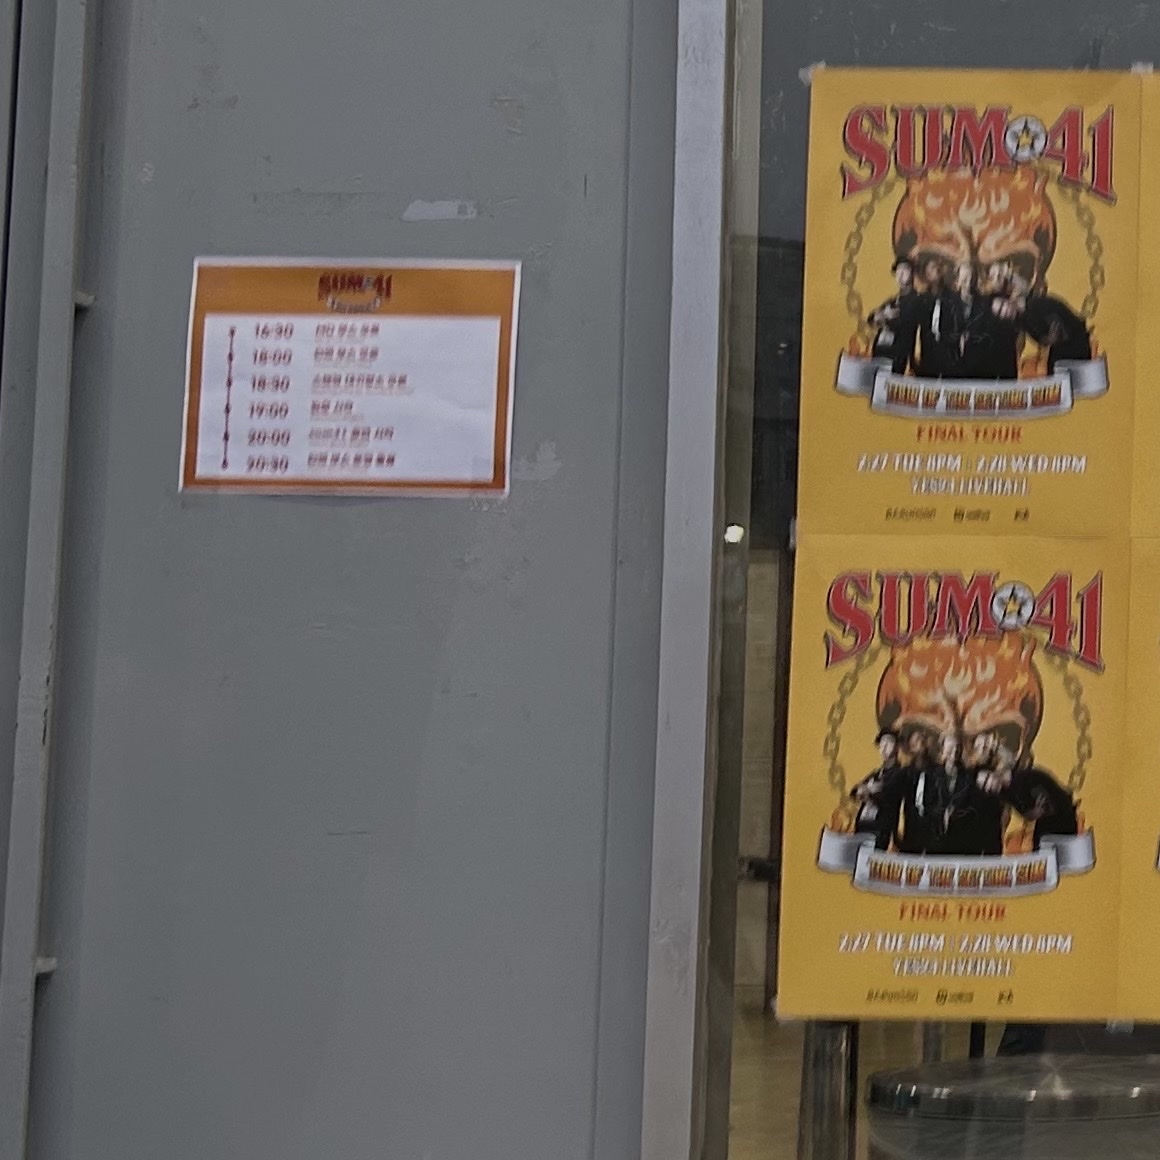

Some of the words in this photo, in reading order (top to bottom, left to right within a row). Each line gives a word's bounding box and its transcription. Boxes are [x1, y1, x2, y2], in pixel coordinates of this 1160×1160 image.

[842, 104, 1011, 199] SUM
[1044, 104, 1116, 204] 41
[917, 424, 964, 443] FINAL
[974, 424, 1023, 443] TOUR
[825, 569, 999, 670] SUM
[1032, 569, 1105, 674] 41
[899, 901, 948, 921] FINAL
[958, 902, 1006, 922] TOUR
